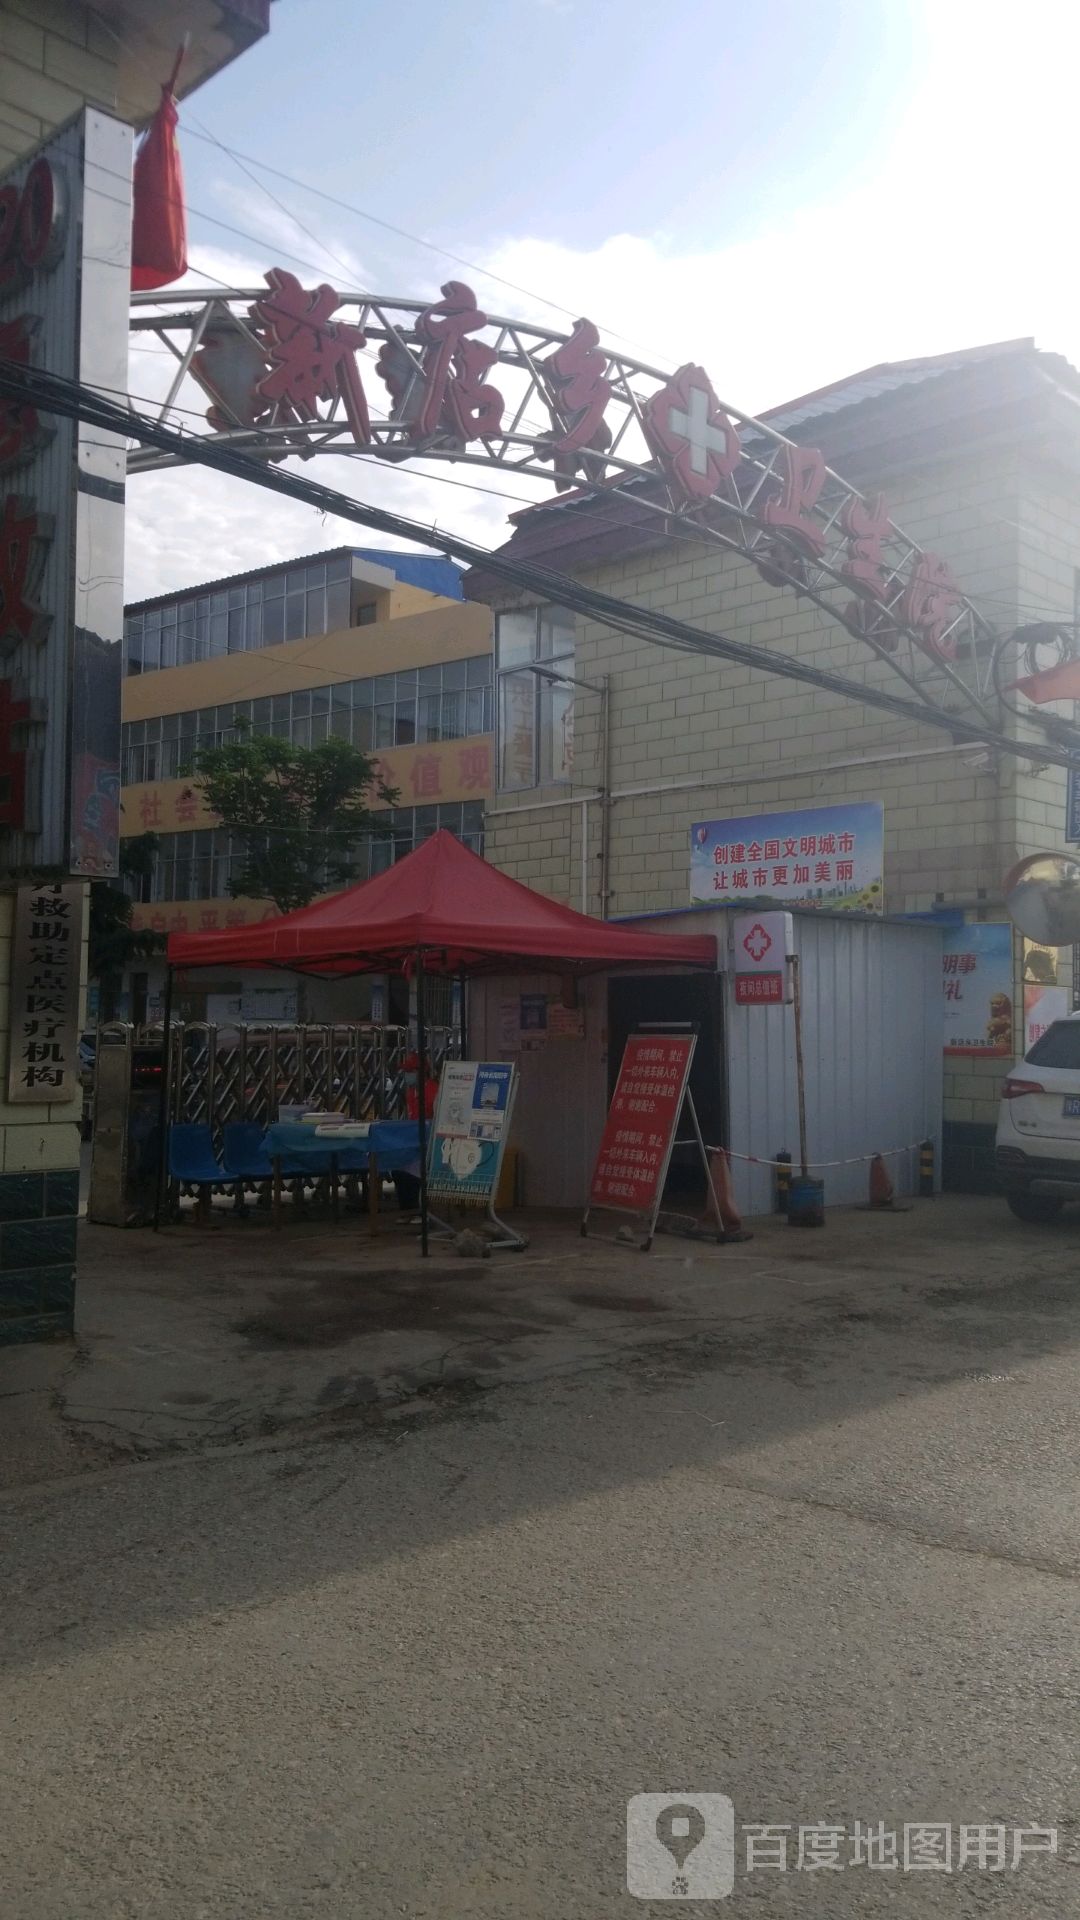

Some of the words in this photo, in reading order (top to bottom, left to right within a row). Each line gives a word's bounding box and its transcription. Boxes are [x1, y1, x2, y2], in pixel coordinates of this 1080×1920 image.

[713, 832, 856, 865] 创建全国文明城市
[712, 860, 855, 891] 让城市更加美丽
